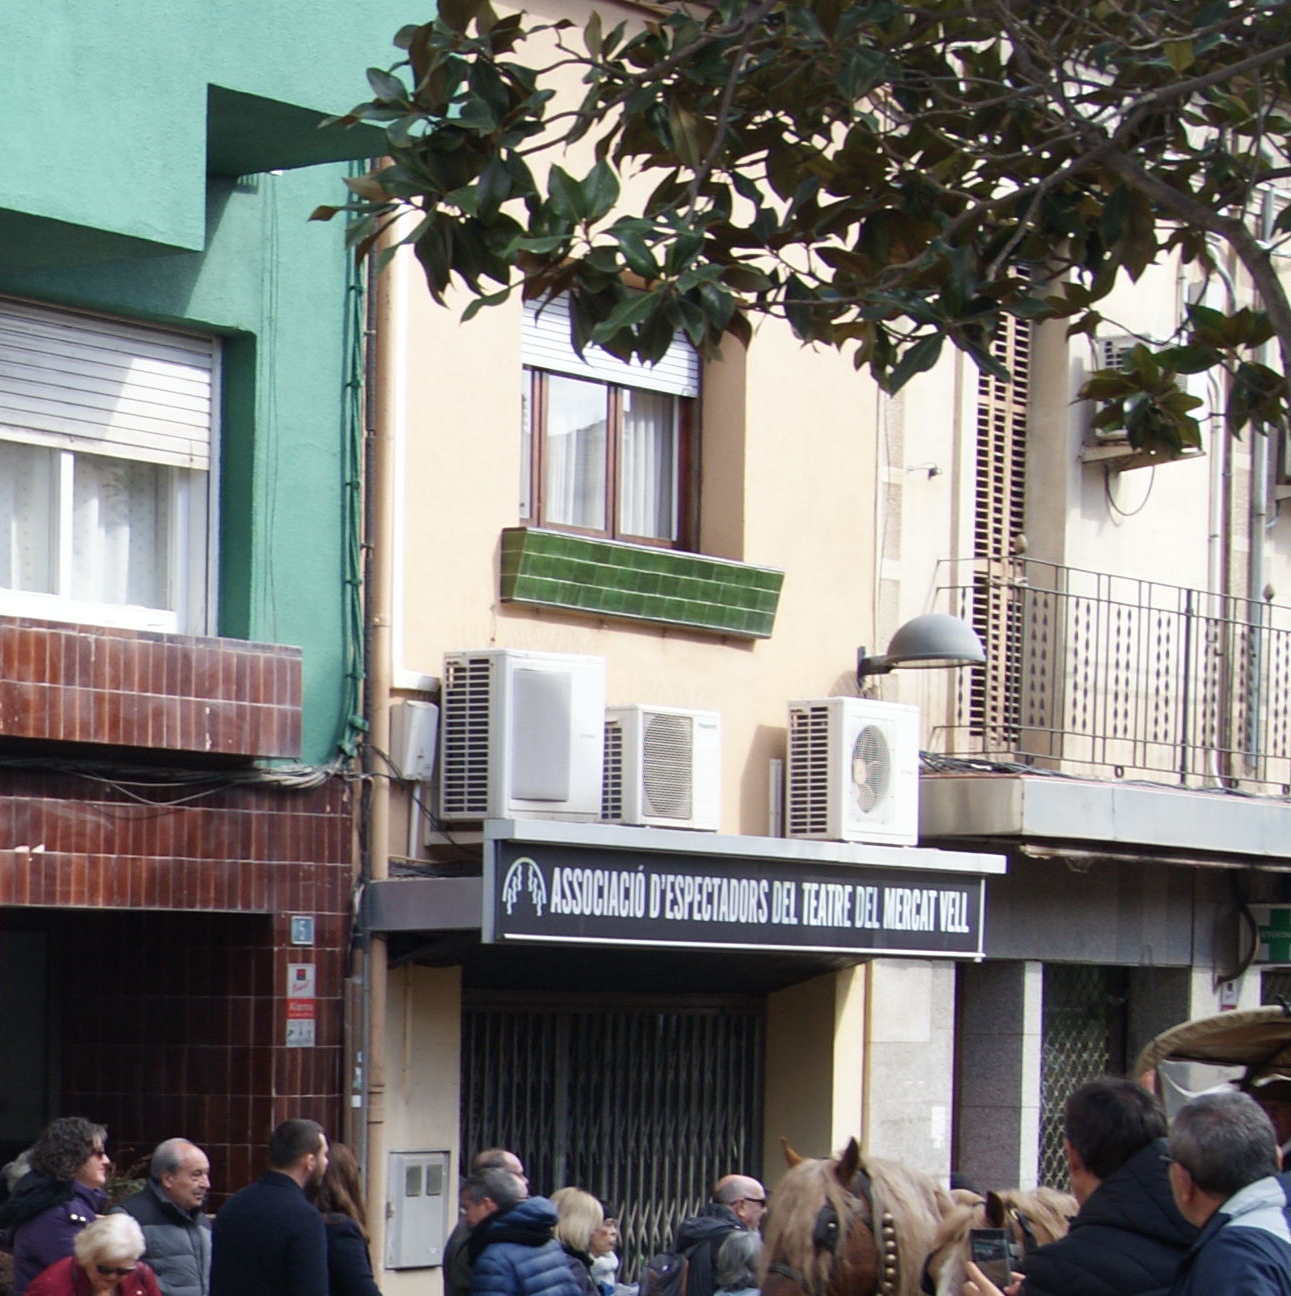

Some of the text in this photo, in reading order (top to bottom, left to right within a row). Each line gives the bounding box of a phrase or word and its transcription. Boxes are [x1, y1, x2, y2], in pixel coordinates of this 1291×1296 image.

[550, 864, 970, 934] ASSOCIACIÓ D'ESPECTADORS DEL TEATRE DEL MERCAT VELL
